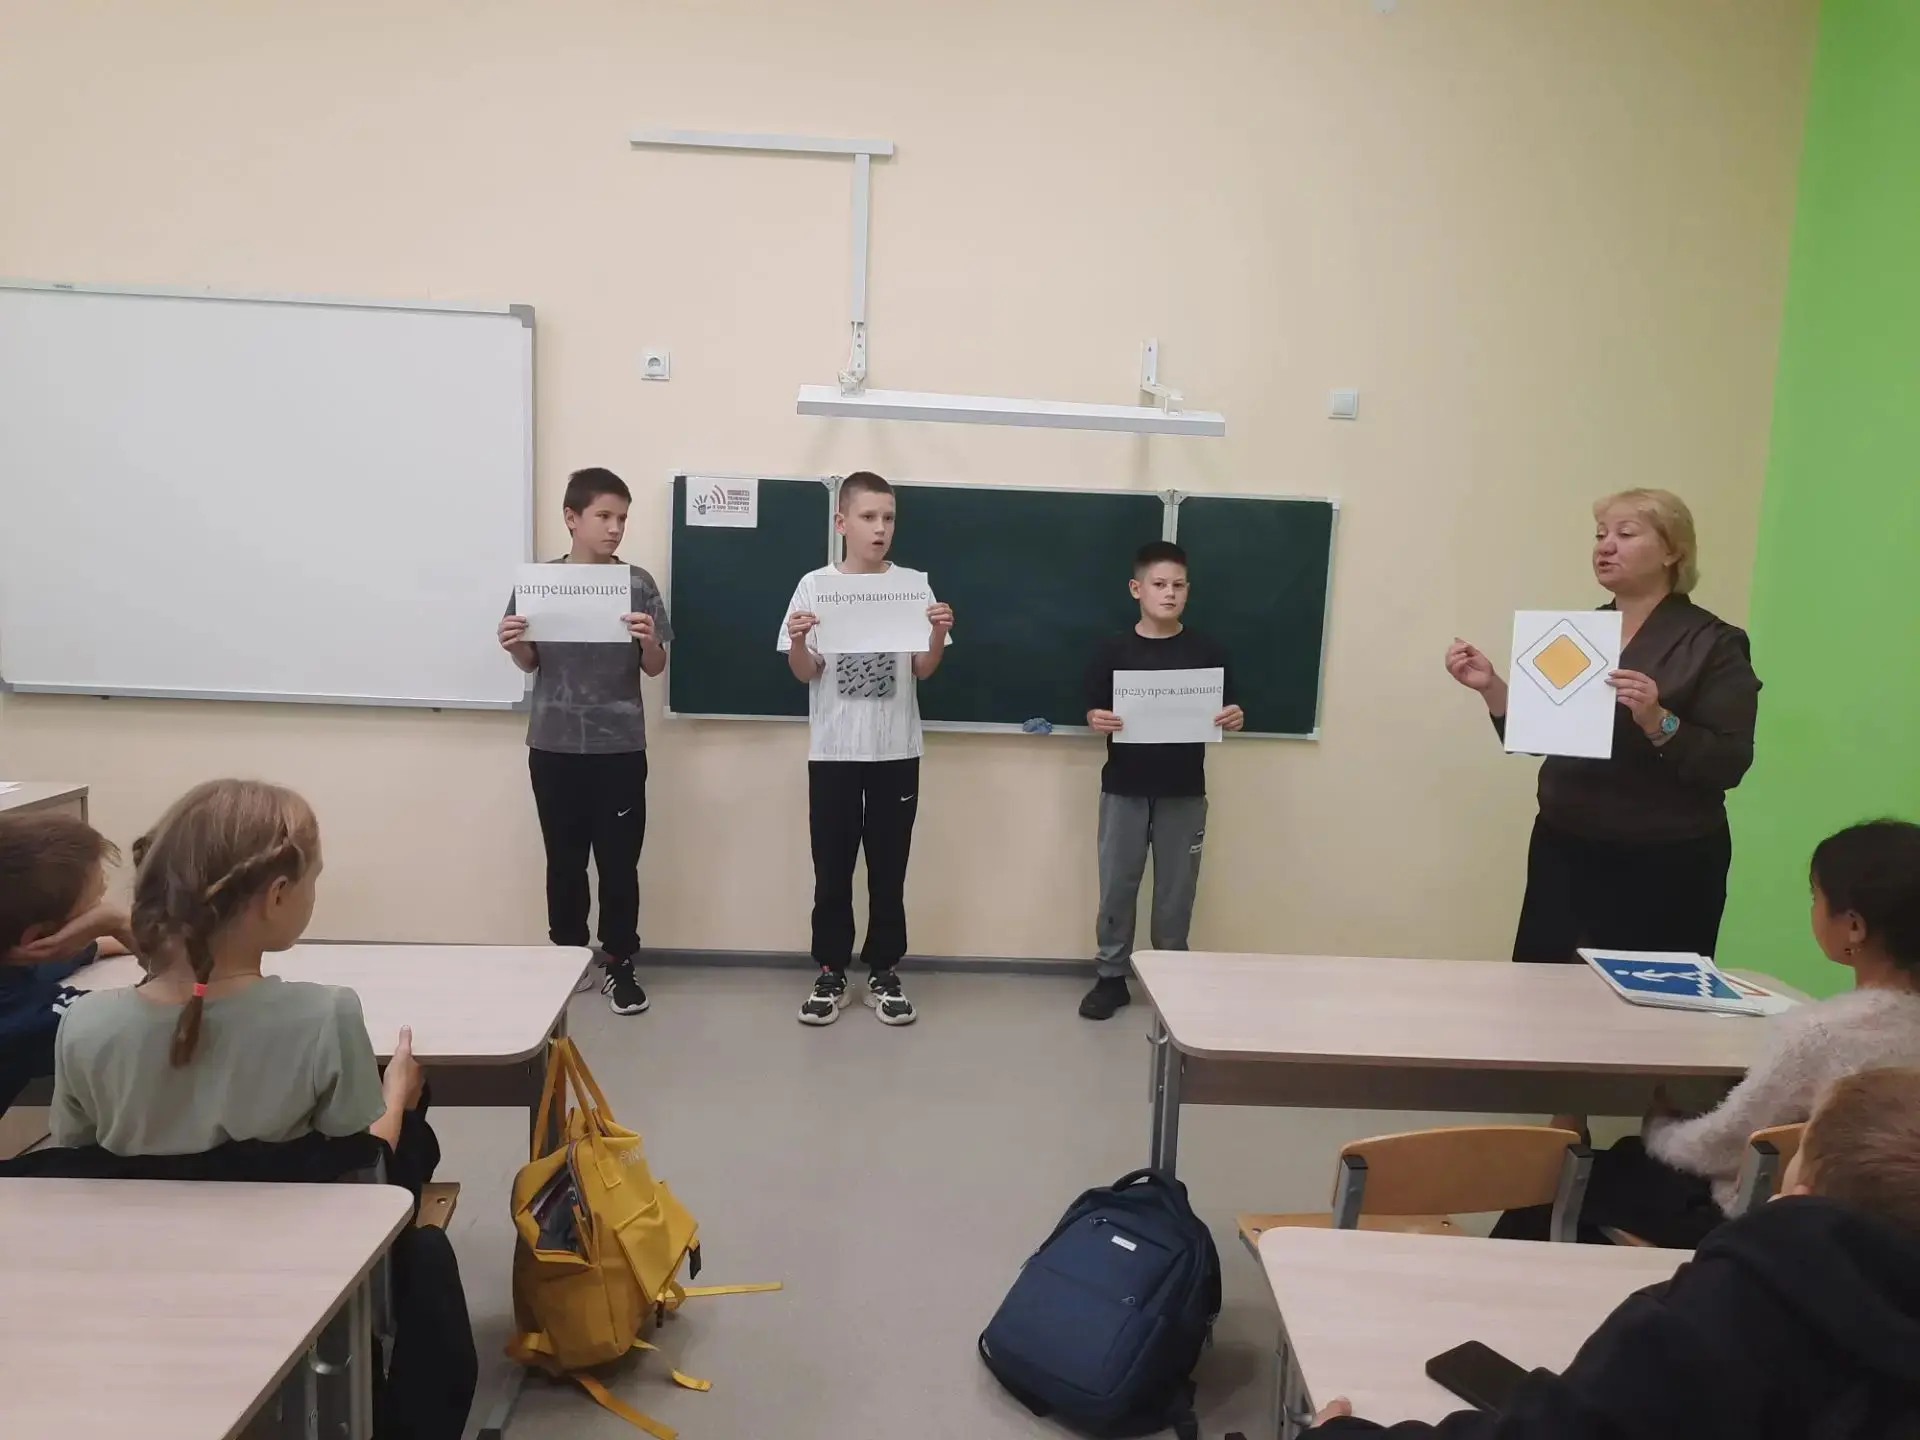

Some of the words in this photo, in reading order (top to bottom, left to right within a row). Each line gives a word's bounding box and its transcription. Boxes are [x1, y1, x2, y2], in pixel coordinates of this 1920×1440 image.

[515, 583, 628, 598] запрещающие
[816, 591, 927, 605] информационные
[1114, 686, 1222, 698] предупреждающие
